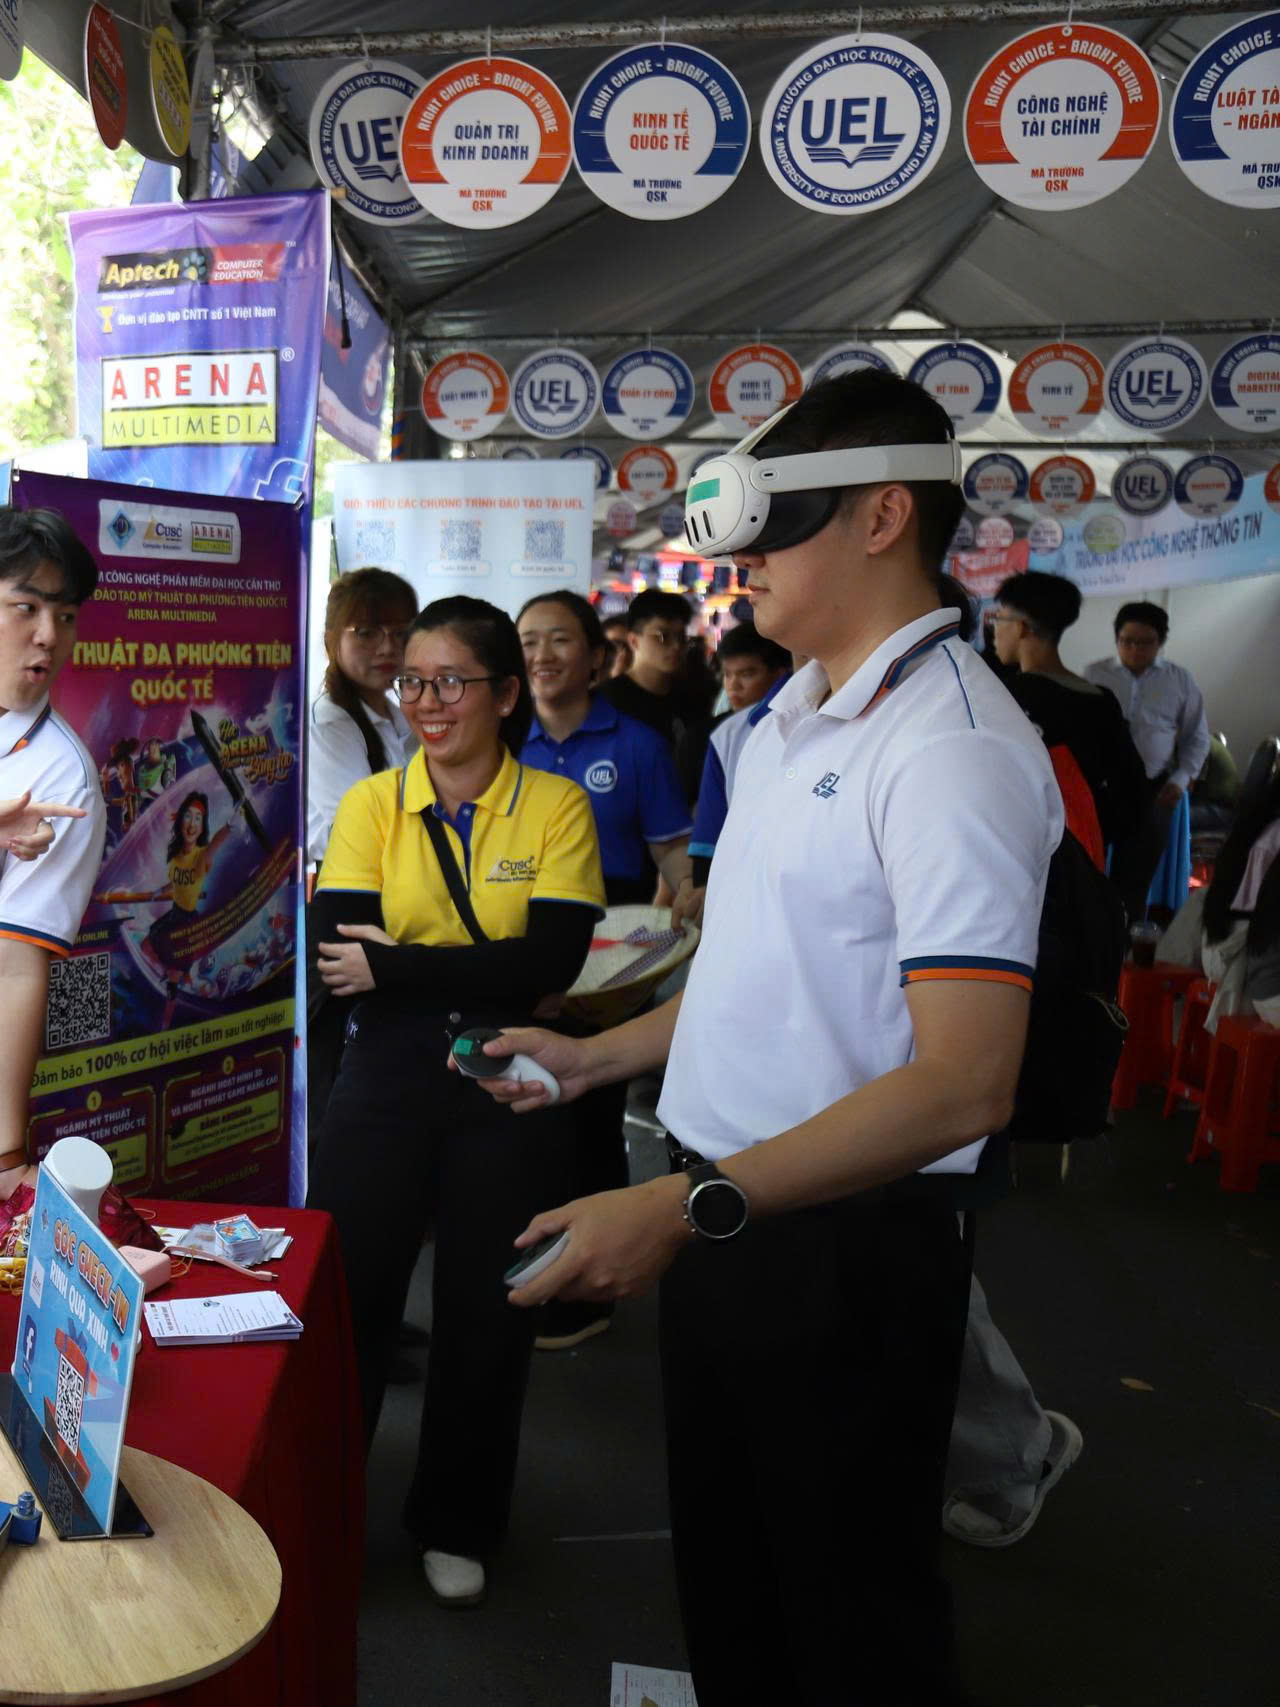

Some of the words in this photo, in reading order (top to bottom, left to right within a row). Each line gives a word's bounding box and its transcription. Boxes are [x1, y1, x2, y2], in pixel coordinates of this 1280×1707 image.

[984, 69, 1012, 108] RIGHT
[1009, 41, 1056, 74] CHOICE
[1071, 39, 1118, 65] BRIGHT
[1112, 59, 1144, 104] FUTURE
[1193, 62, 1224, 102] RIGHT
[1221, 30, 1272, 66] CHOICE
[380, 76, 407, 92] KINH
[589, 85, 614, 119] RIGHT
[611, 59, 653, 89] CHOICE
[667, 58, 709, 85] BRIGHT
[704, 80, 734, 122] FUTURE
[778, 72, 813, 121] TRƯỜNG
[813, 56, 838, 74] ĐẠI
[839, 50, 867, 63] HỌC
[870, 50, 903, 68] KINH
[418, 98, 442, 132] RIGHT
[440, 73, 481, 101] CHOICE
[494, 72, 536, 98] BRIGHT
[531, 95, 559, 134] FUTURE
[1017, 95, 1060, 115] CÔNG
[1066, 92, 1108, 115] NGHỆ
[1217, 87, 1256, 111] LUẬT
[632, 112, 667, 128] KINH
[673, 107, 689, 129] TẾ
[801, 96, 907, 148] UEL
[1021, 117, 1045, 137] TÀI
[1051, 116, 1101, 136] CHÍNH
[455, 120, 492, 140] QUẢN
[498, 125, 519, 143] TRỊ
[630, 129, 669, 150] QUỐC
[674, 130, 690, 151] TẾ
[442, 146, 476, 160] KINH
[481, 146, 529, 160] DOANH
[775, 137, 816, 195] UNIVERSITY
[814, 189, 832, 202] OF
[831, 178, 901, 205] ECONOMICS
[899, 159, 921, 183] AND
[917, 132, 934, 161] LAW
[646, 190, 668, 203] QSK
[1045, 180, 1068, 193] QSK
[472, 200, 493, 211] QSK
[104, 257, 180, 286] Aptech
[214, 269, 264, 281] EDUCATION
[217, 259, 264, 272] COMPUTER
[182, 309, 209, 322] CNTT
[232, 306, 252, 320] Việt
[254, 305, 276, 318] Nam
[111, 362, 268, 400] ARENA
[530, 380, 580, 404] UEL
[1125, 370, 1183, 397] UEL
[110, 414, 273, 439] MULTIMEDIA
[194, 525, 232, 540] ARENA
[1243, 511, 1263, 539] TIN
[106, 571, 132, 586] CÔNG
[128, 609, 159, 621] ARENA
[161, 610, 217, 623] MULTIMEDIA
[73, 636, 139, 672] THUẬT
[143, 642, 171, 666] ĐA
[176, 640, 252, 666] PHƯƠNG
[255, 640, 292, 671] TIỆN
[131, 670, 187, 706] QUỐC
[192, 668, 214, 699] TẾ
[173, 866, 195, 886] CUSC
[61, 1064, 83, 1081] bảo
[86, 1053, 128, 1075] 100%
[130, 1045, 148, 1064] cơ
[149, 1039, 170, 1062] hội
[174, 1031, 200, 1055] việc
[201, 1024, 223, 1045] làm
[225, 1027, 240, 1039] sau
[77, 1240, 131, 1336] CHECK-IN
[49, 1259, 68, 1301] RINH
[86, 1308, 110, 1355] XINH
